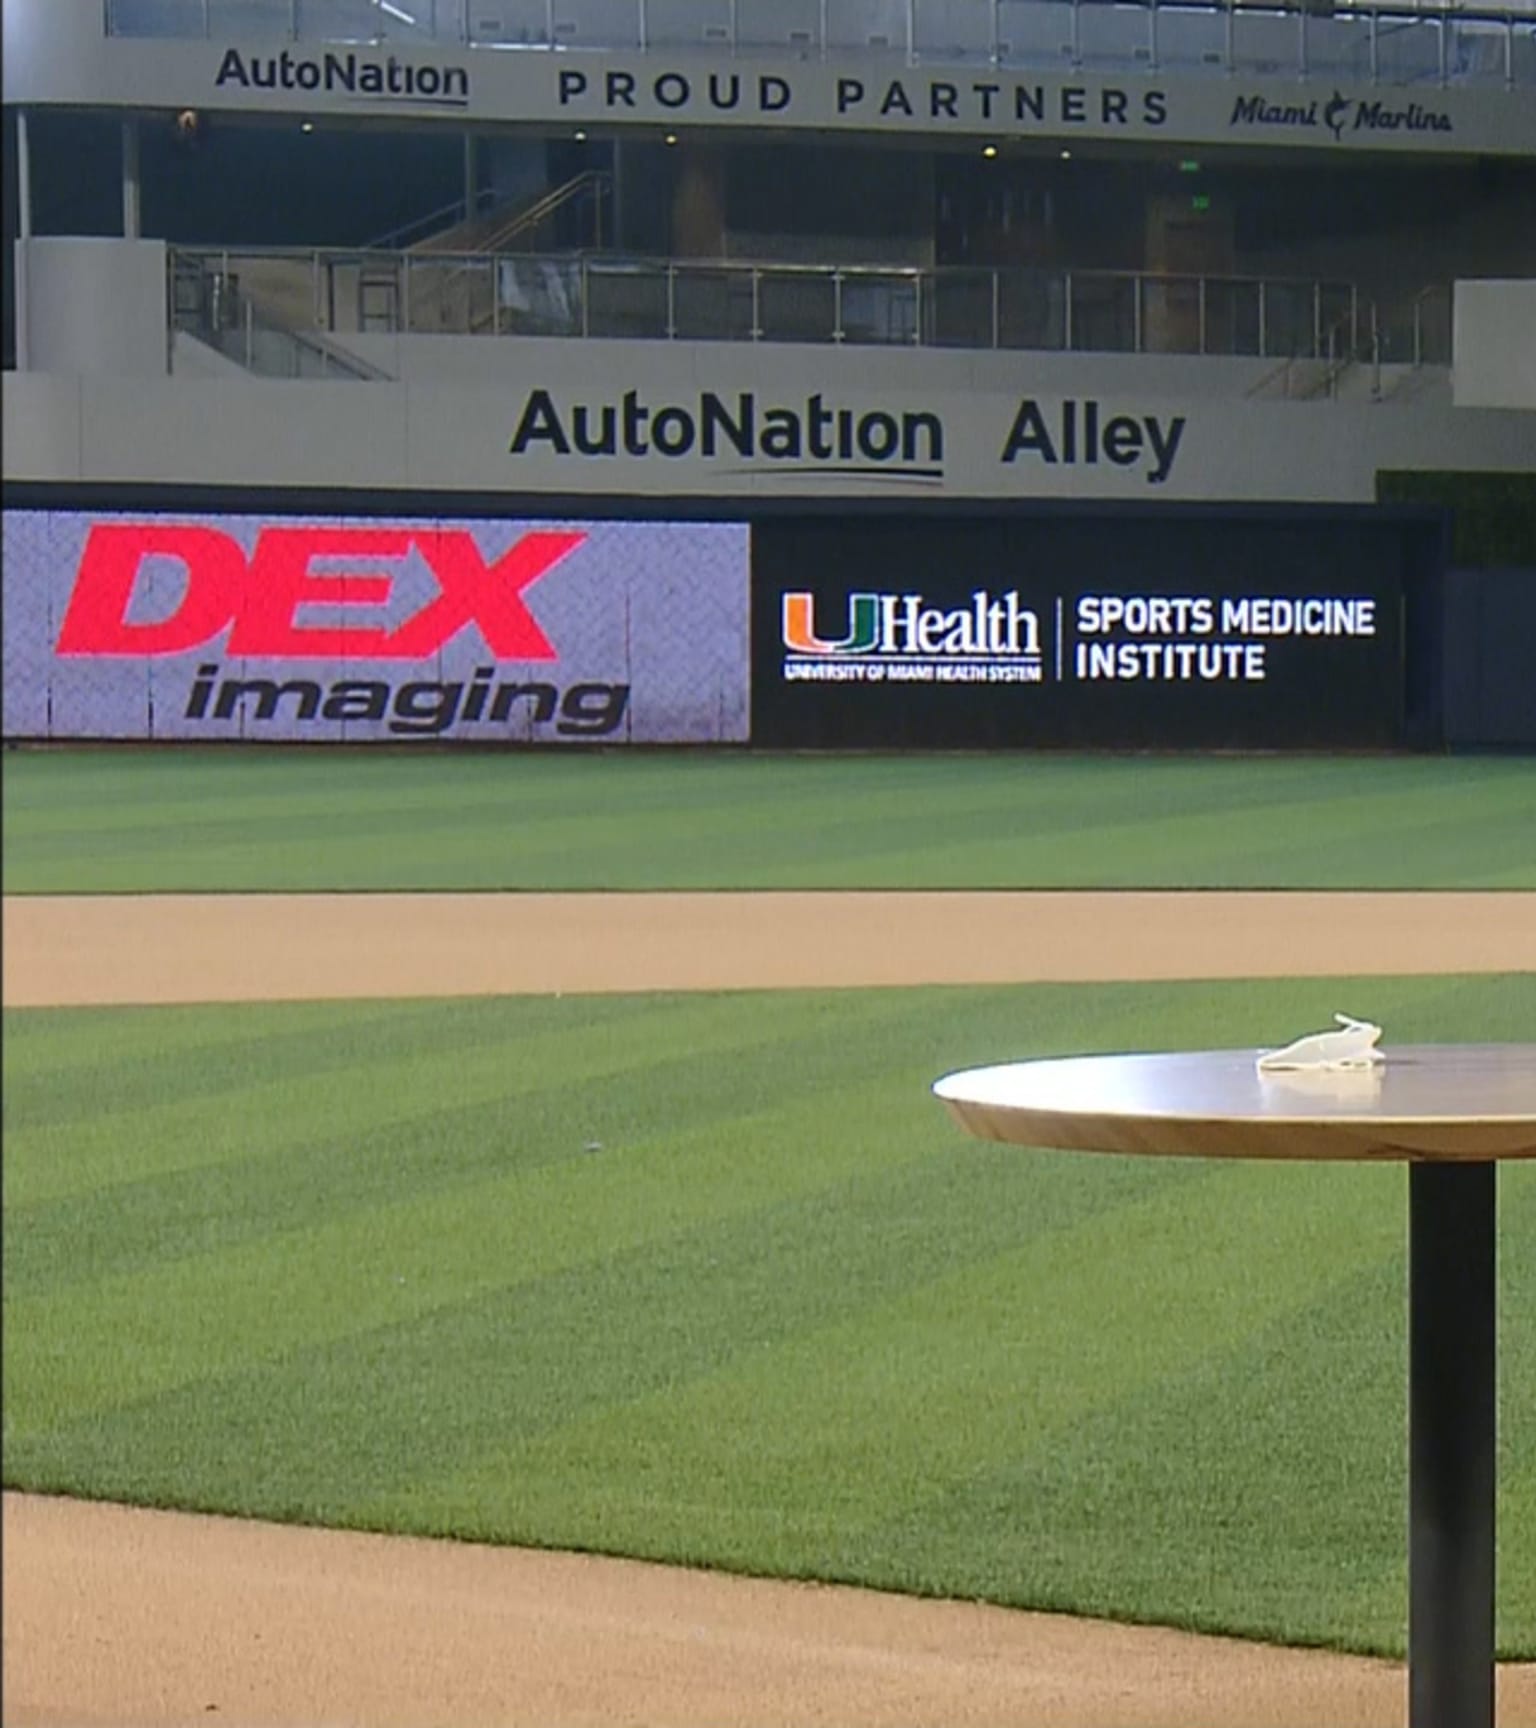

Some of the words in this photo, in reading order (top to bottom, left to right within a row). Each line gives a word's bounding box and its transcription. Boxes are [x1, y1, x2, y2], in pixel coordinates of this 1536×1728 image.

[216, 48, 469, 96] AutoNation
[559, 70, 791, 111] PROUD
[837, 78, 1167, 126] PARTNERS
[1230, 96, 1317, 126] Miami
[1353, 100, 1453, 131] Marlins
[510, 389, 943, 461] AutoNation
[1001, 400, 1186, 484] Alley
[55, 522, 588, 662] DEX
[1077, 597, 1213, 634] SPORTS
[1222, 599, 1376, 635] MEDICINE
[784, 663, 866, 681] UNIVERSITY
[866, 663, 886, 681] OF
[887, 664, 935, 681] MIAMI
[936, 664, 987, 681] HEALTH
[988, 664, 1042, 682] SYSTEM
[1077, 643, 1266, 679] INSTITUTE
[185, 664, 631, 735] imaging
